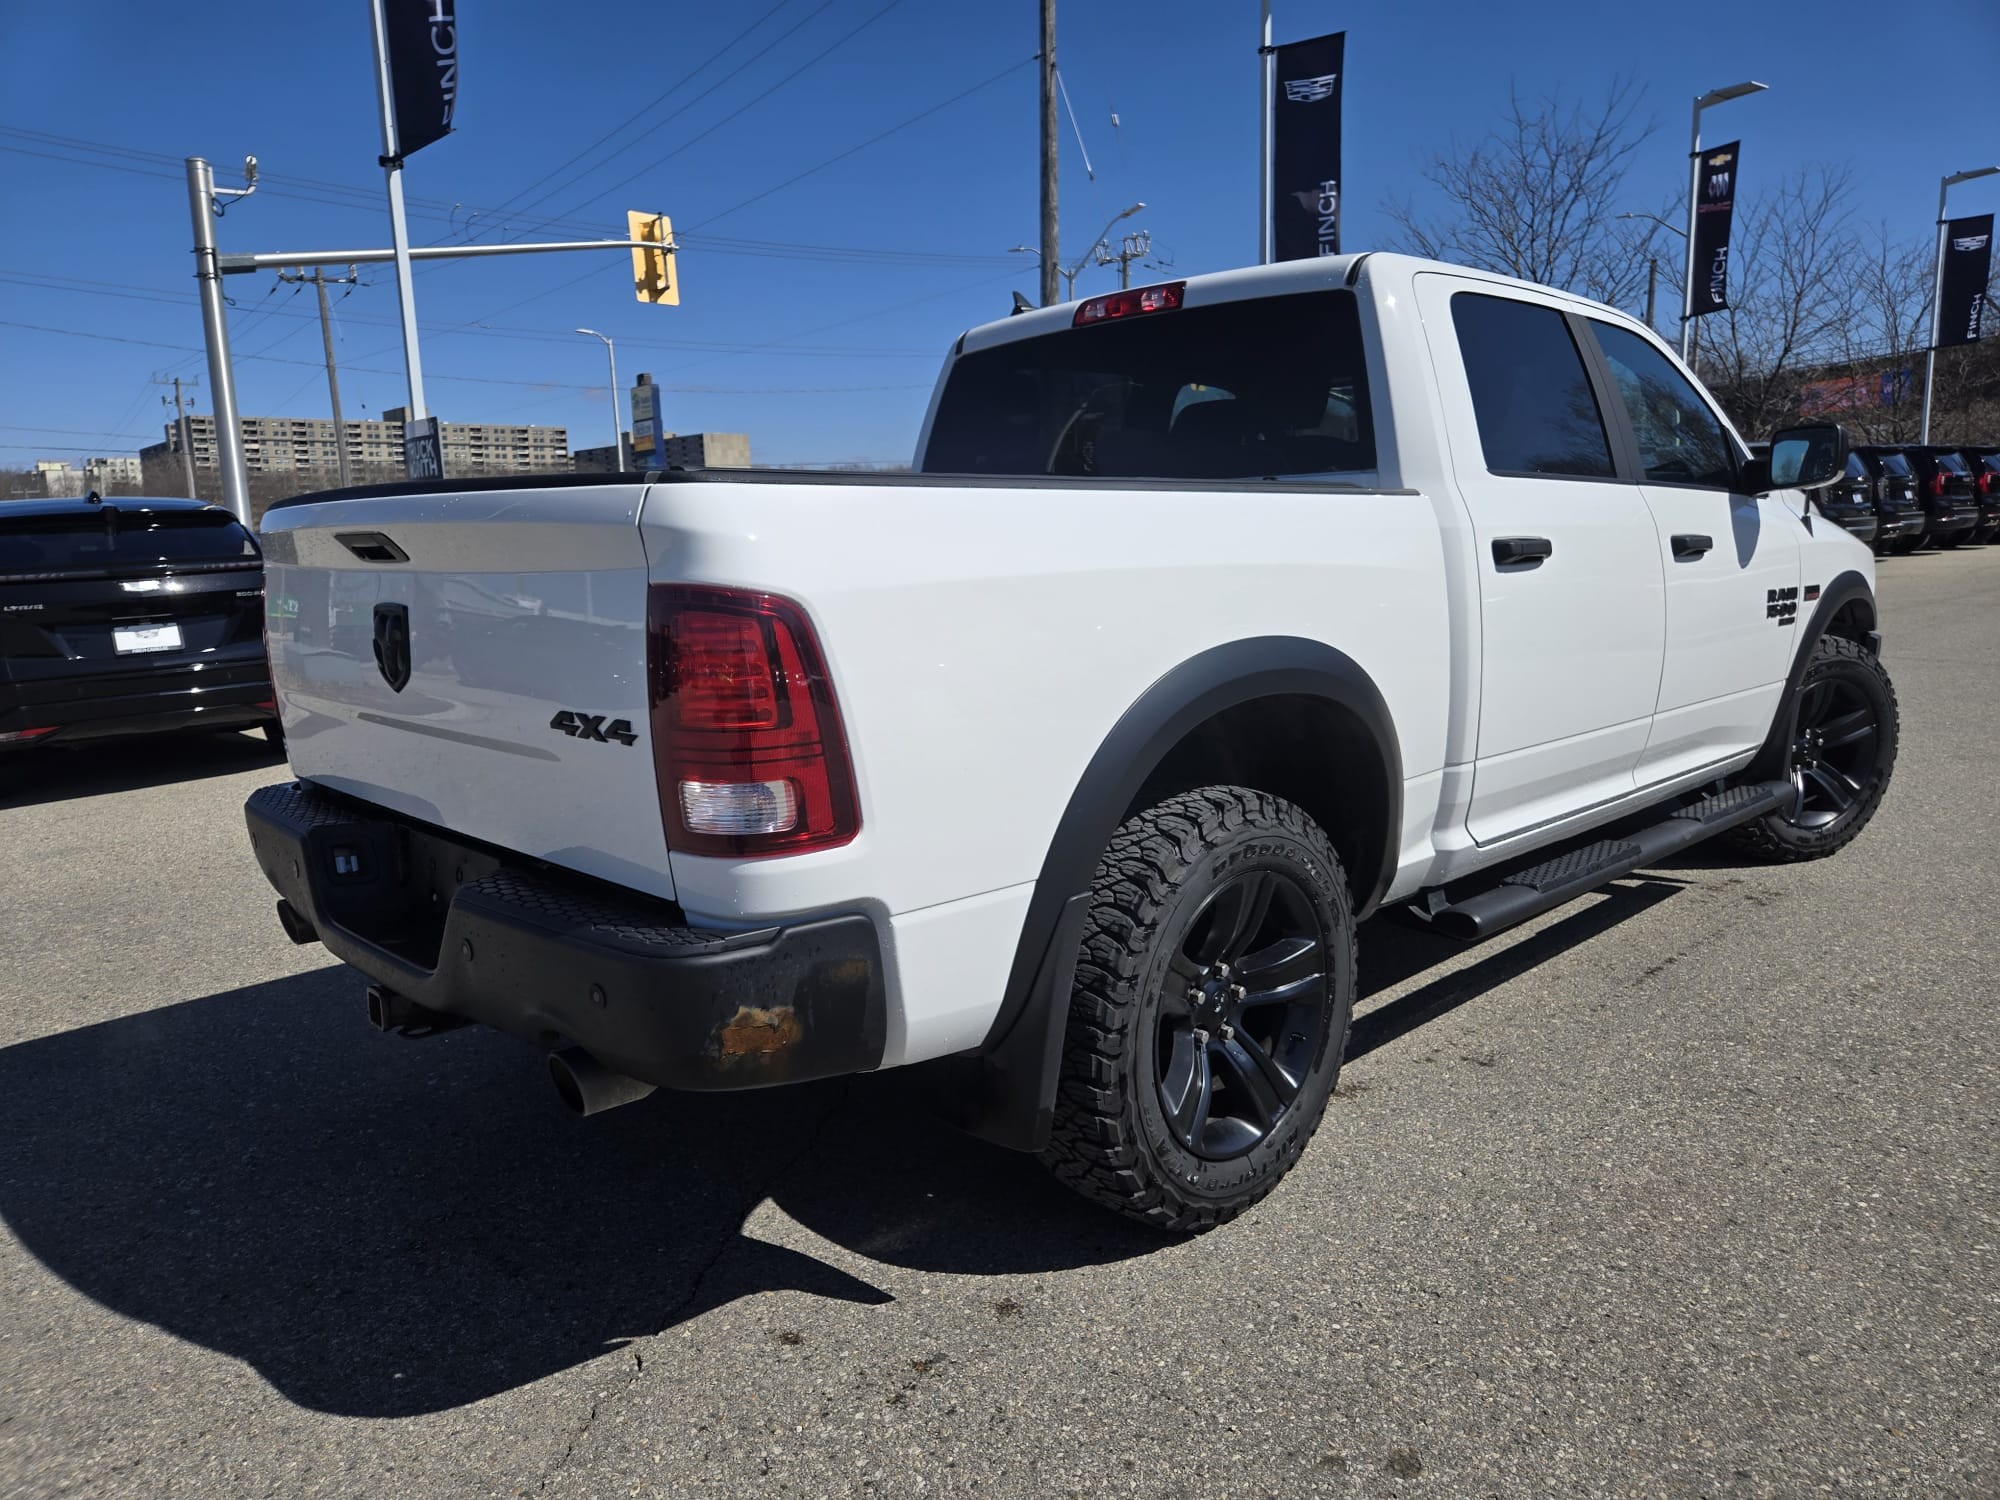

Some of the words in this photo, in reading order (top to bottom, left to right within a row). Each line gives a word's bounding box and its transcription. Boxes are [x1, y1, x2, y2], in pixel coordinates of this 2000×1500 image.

[1318, 179, 1337, 257] FINCH
[1711, 246, 1728, 304] FINCH
[1966, 293, 1982, 339] FINCH
